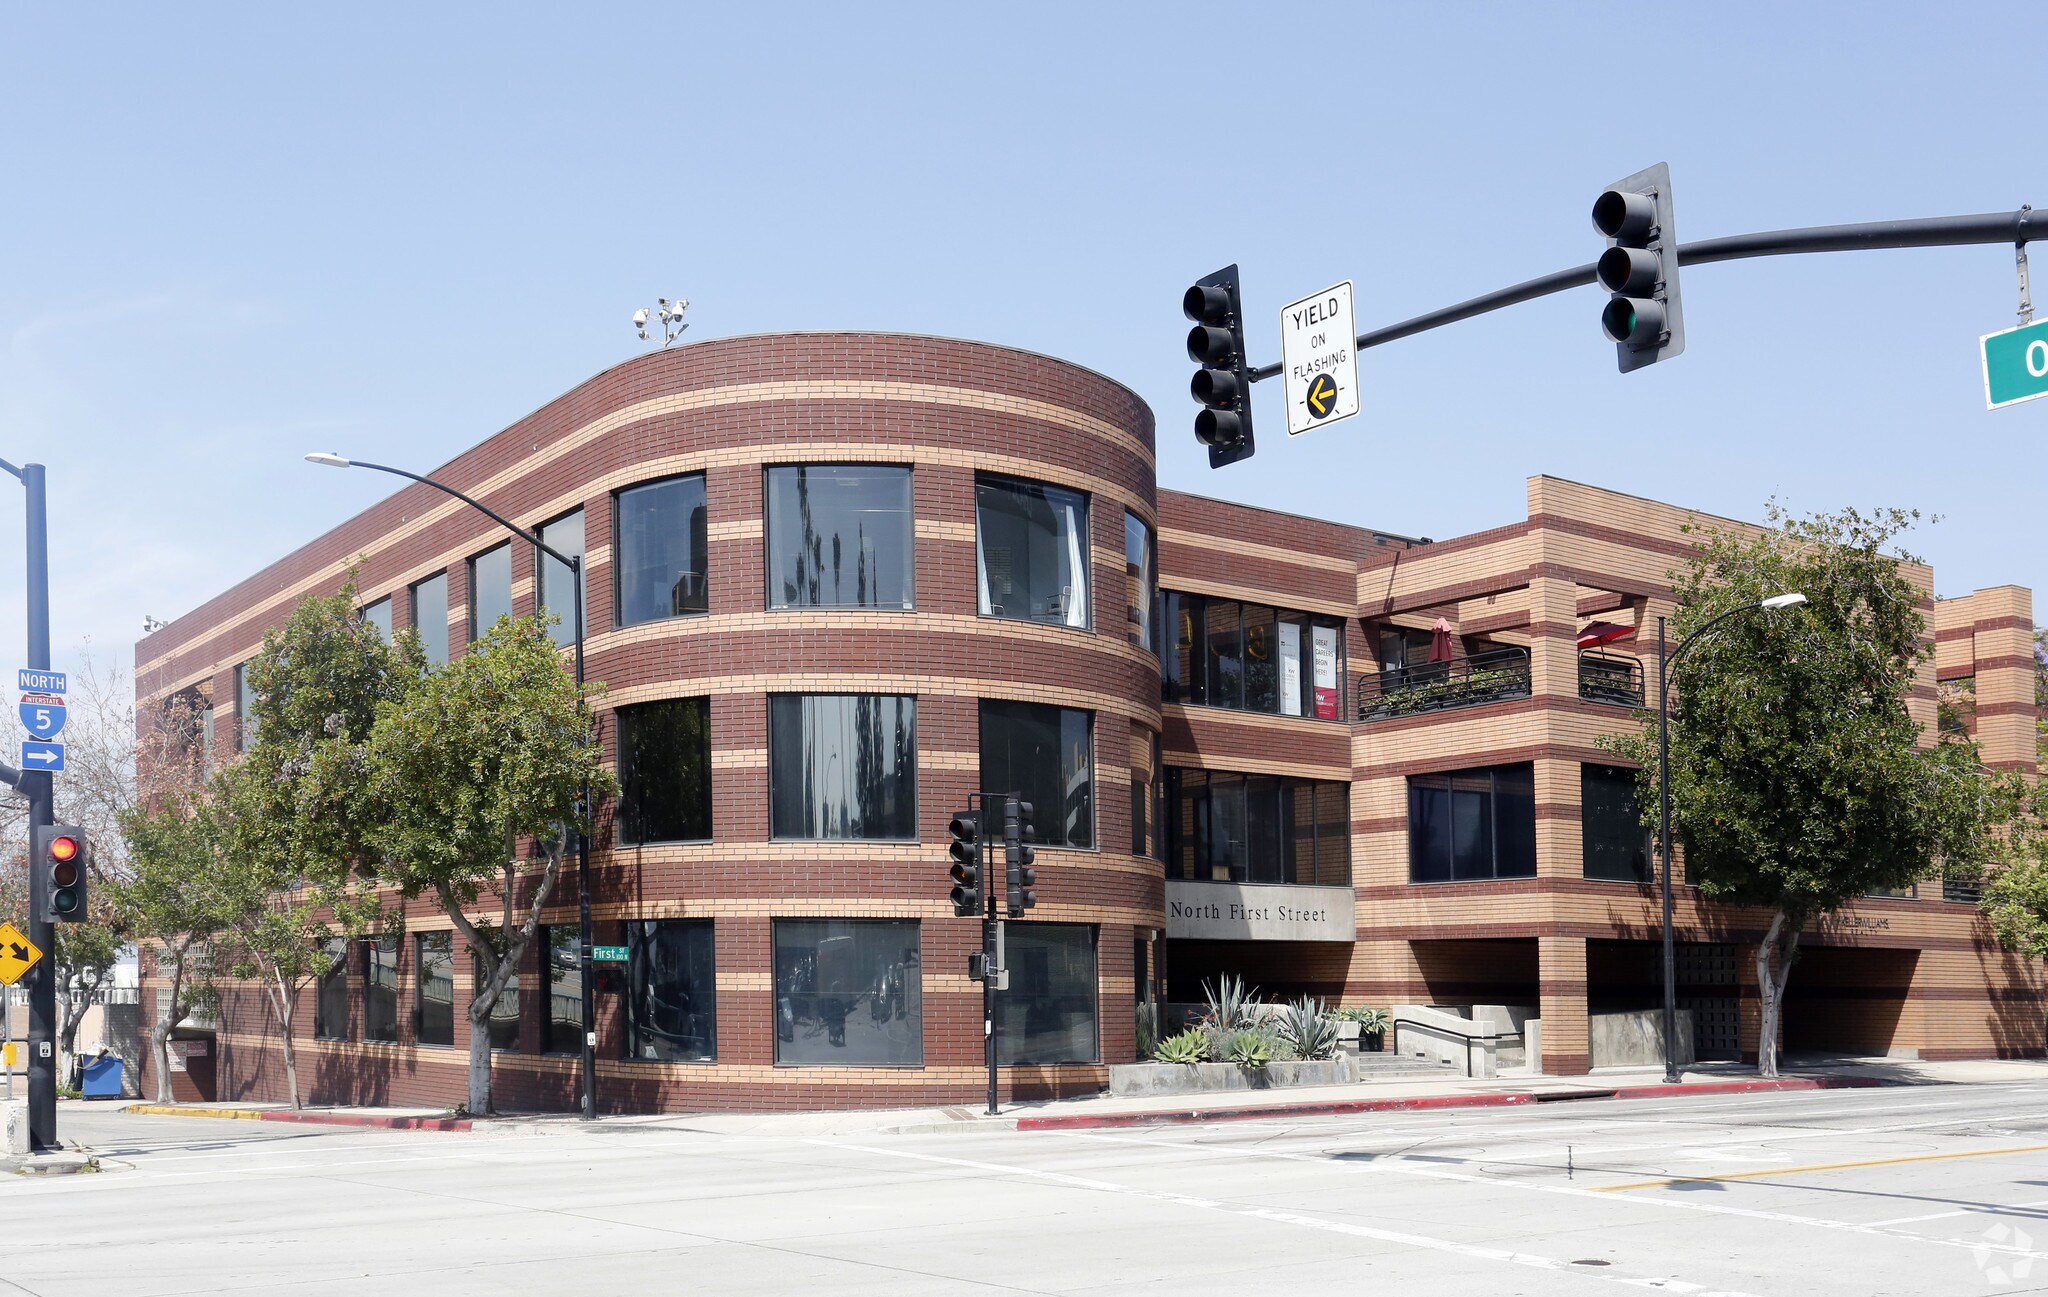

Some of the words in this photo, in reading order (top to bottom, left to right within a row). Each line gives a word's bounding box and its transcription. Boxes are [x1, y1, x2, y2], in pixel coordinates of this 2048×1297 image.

[1293, 297, 1338, 331] YIELD
[1311, 332, 1326, 349] ON
[1294, 349, 1347, 380] FLASHING
[1315, 638, 1328, 647] GREAT
[1315, 648, 1334, 658] CAREERS
[20, 672, 65, 690] NORTH
[25, 696, 60, 705] INTERSTATE
[36, 708, 52, 730] 5
[1170, 901, 1220, 919] North
[1229, 904, 1269, 920] First
[1278, 905, 1326, 922] Street
[593, 947, 616, 959] First
